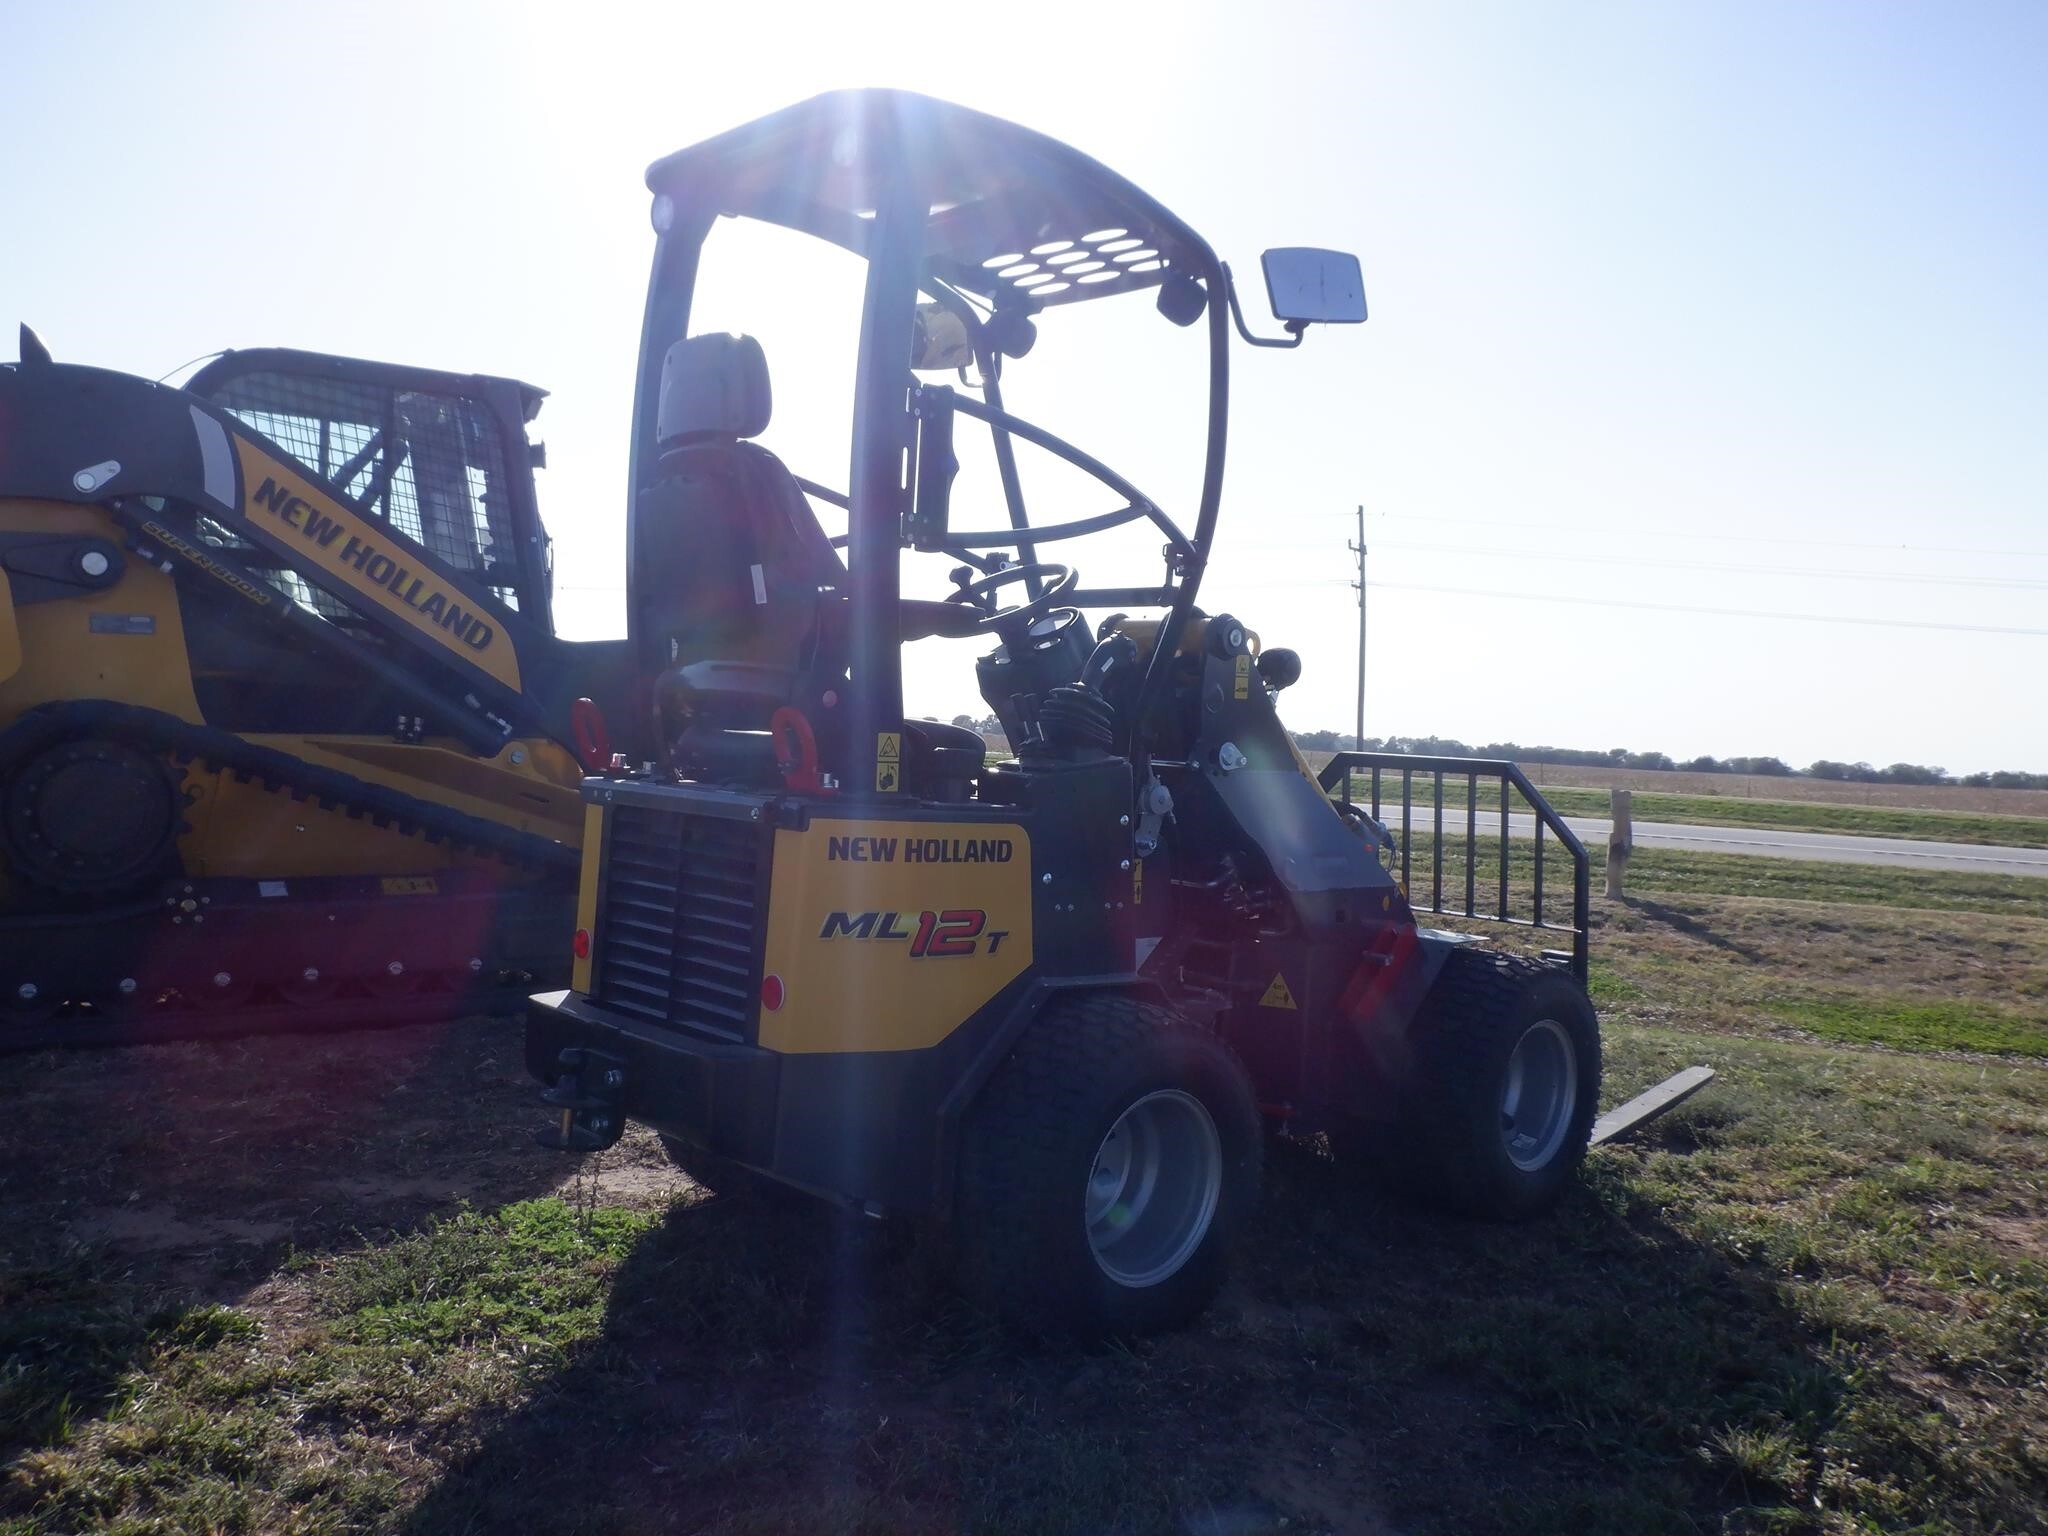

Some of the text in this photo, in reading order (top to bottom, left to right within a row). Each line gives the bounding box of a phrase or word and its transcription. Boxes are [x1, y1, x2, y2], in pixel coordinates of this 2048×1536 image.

[142, 521, 271, 605] SUPER BOOM
[253, 477, 493, 651] NEW HOLLAND
[828, 836, 1013, 863] NEW HOLLAND
